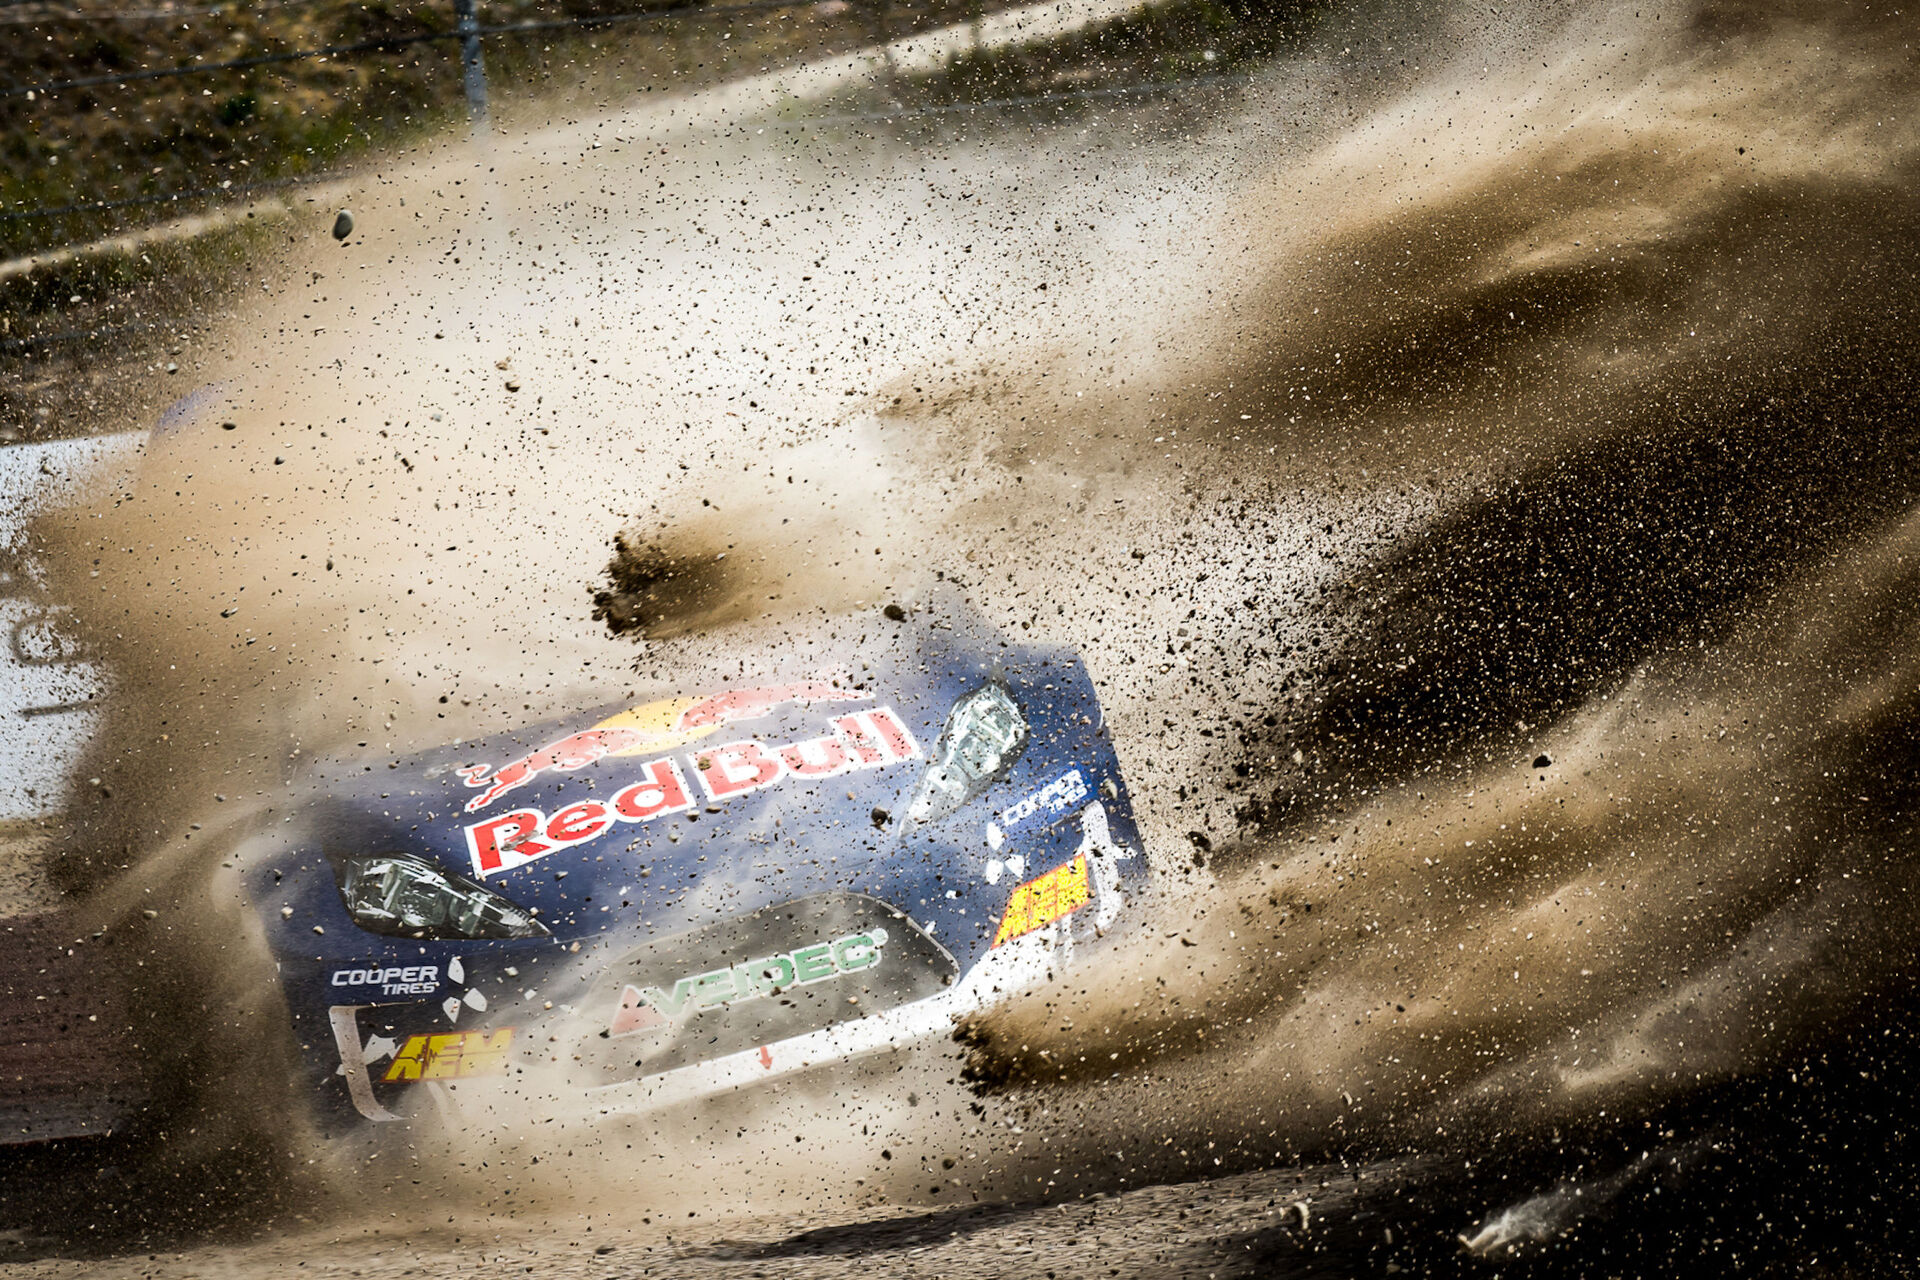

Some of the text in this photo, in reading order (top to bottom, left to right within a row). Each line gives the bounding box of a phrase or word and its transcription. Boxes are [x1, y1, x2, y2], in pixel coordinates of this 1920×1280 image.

[464, 706, 924, 880] Red Bull
[331, 966, 438, 986] COOPER
[381, 982, 437, 996] TIRES
[645, 930, 885, 1018] VEIDEC
[379, 1028, 517, 1083] AEM
